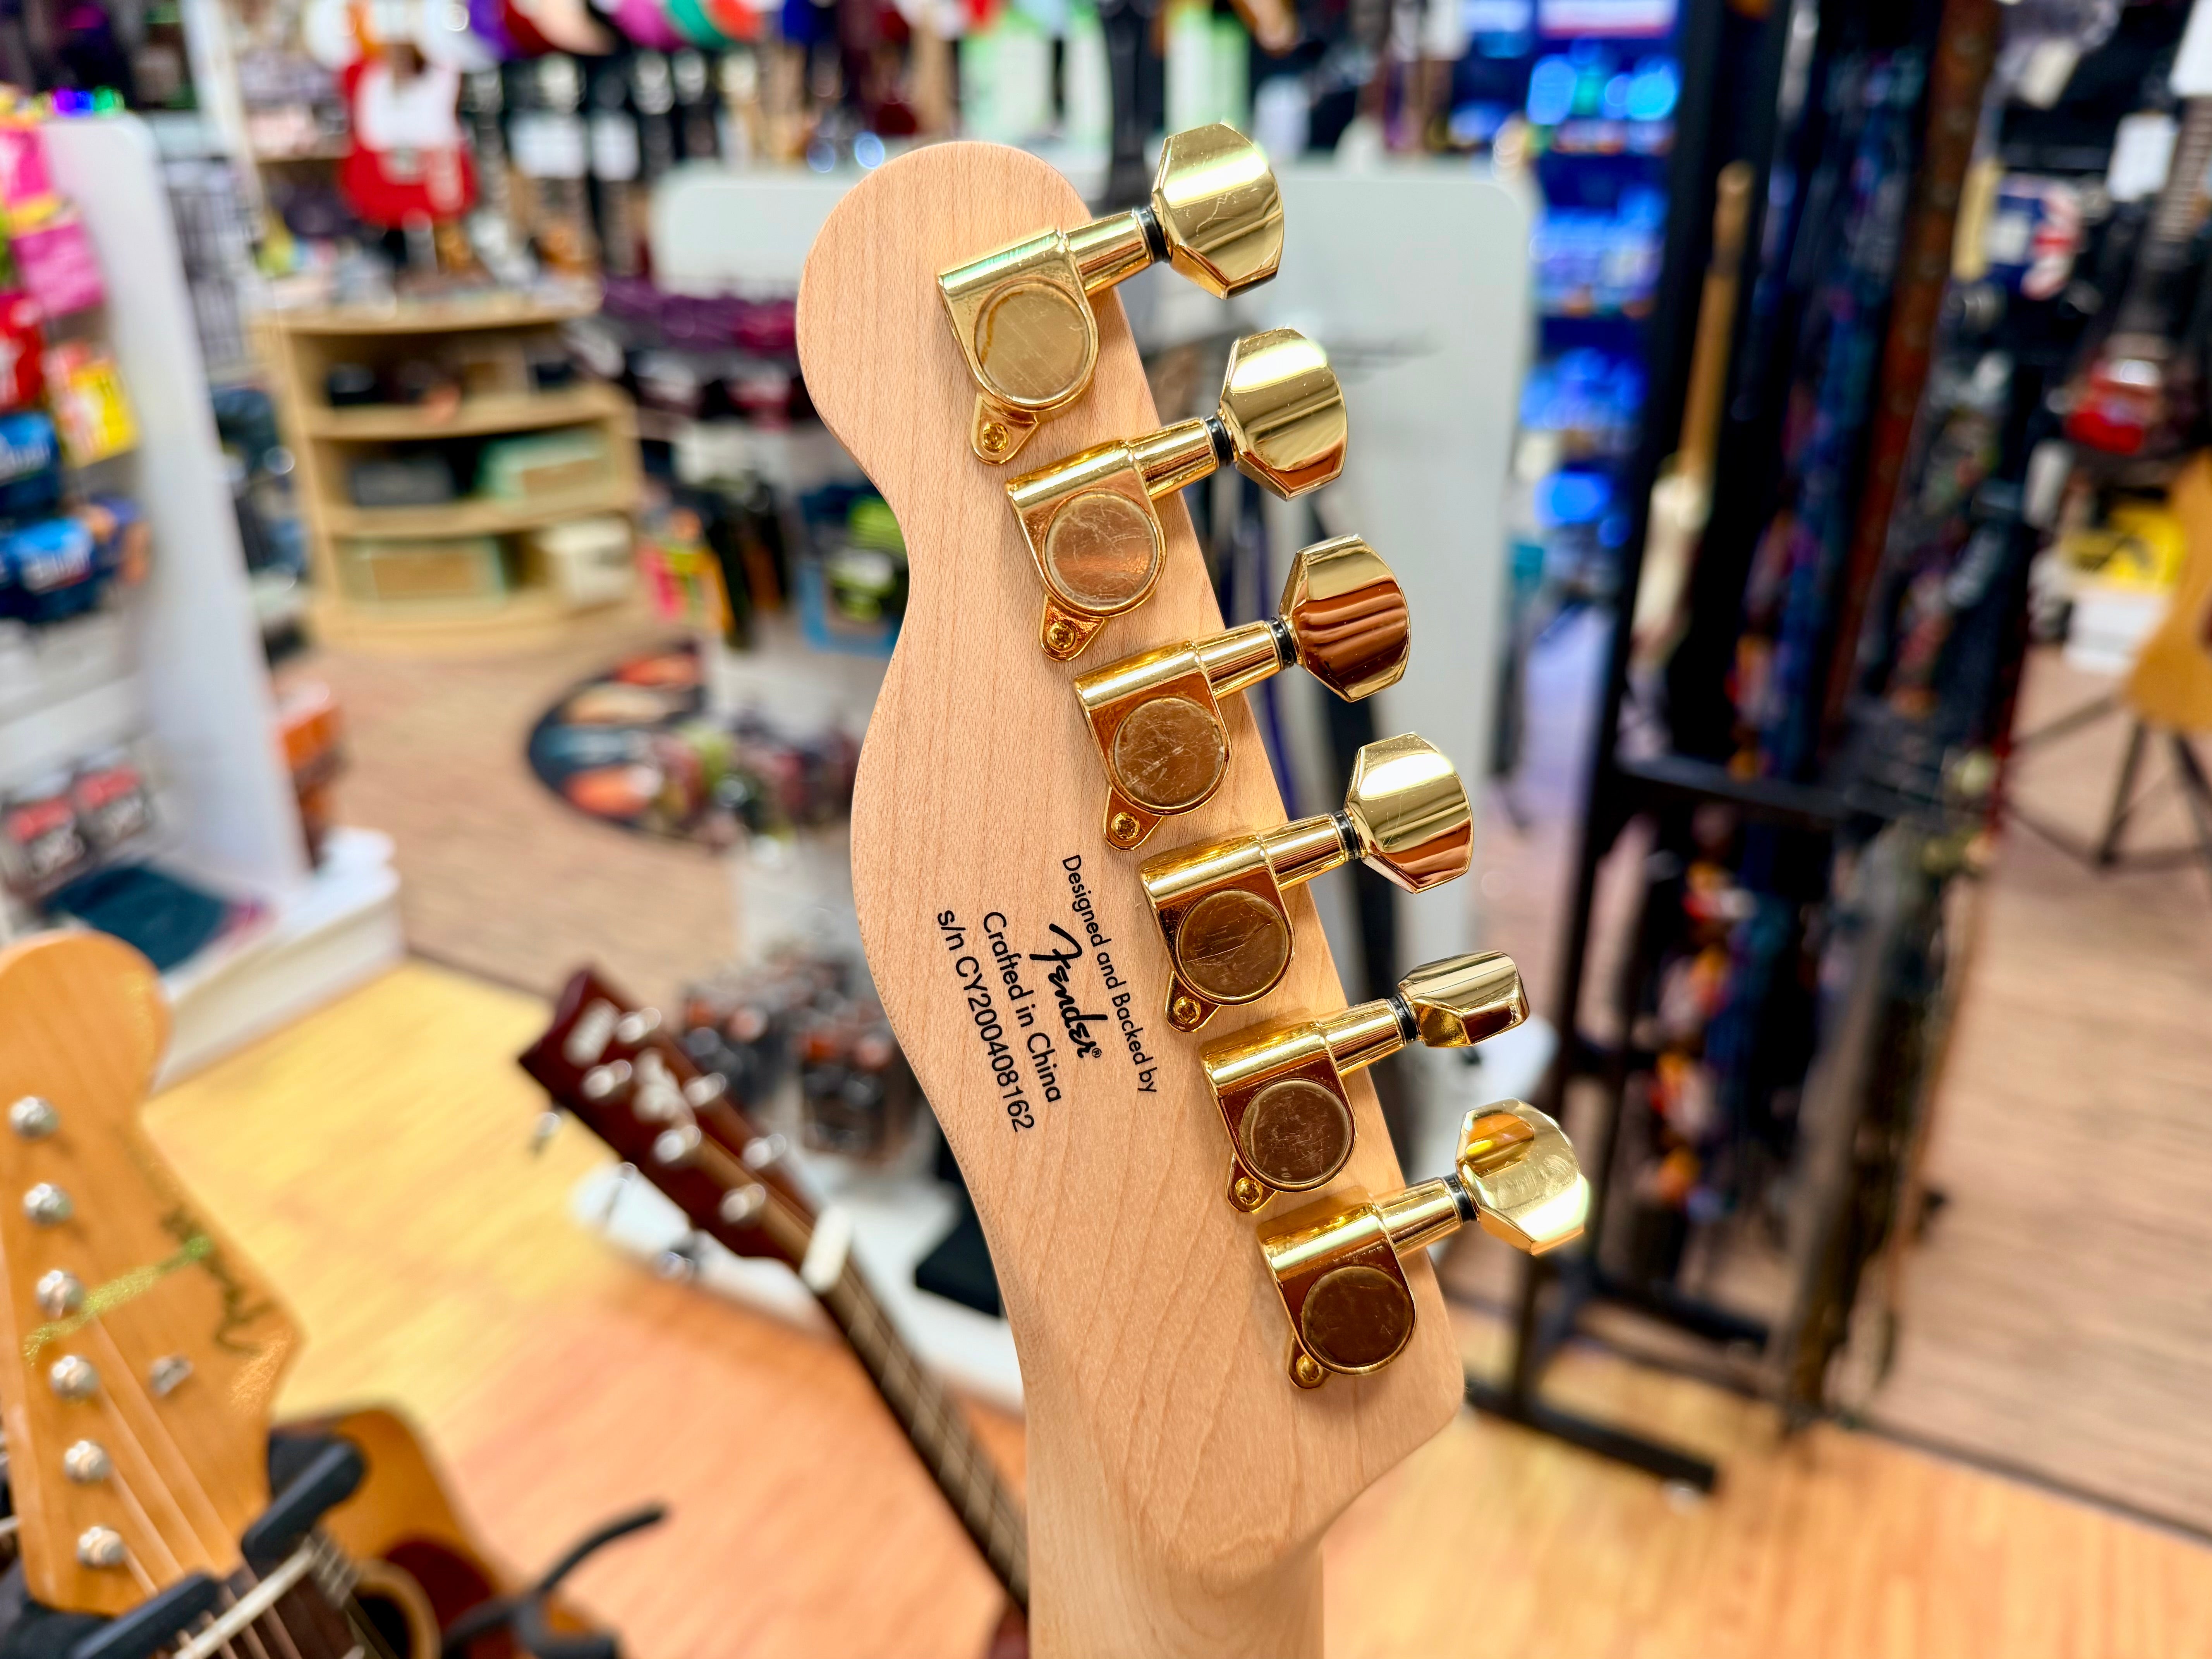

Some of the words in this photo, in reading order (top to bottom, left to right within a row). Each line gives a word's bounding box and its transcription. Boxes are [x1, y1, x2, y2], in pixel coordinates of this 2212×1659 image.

[1062, 854, 1112, 947] Designed
[983, 912, 1034, 1001] Crafted
[1015, 1003, 1036, 1028] in
[1027, 1032, 1061, 1103] China
[1097, 952, 1127, 990] and
[937, 910, 966, 951] s/n
[955, 956, 1035, 1132] CY200408162
[1111, 992, 1154, 1065] Backed
[1137, 1066, 1158, 1092] by
